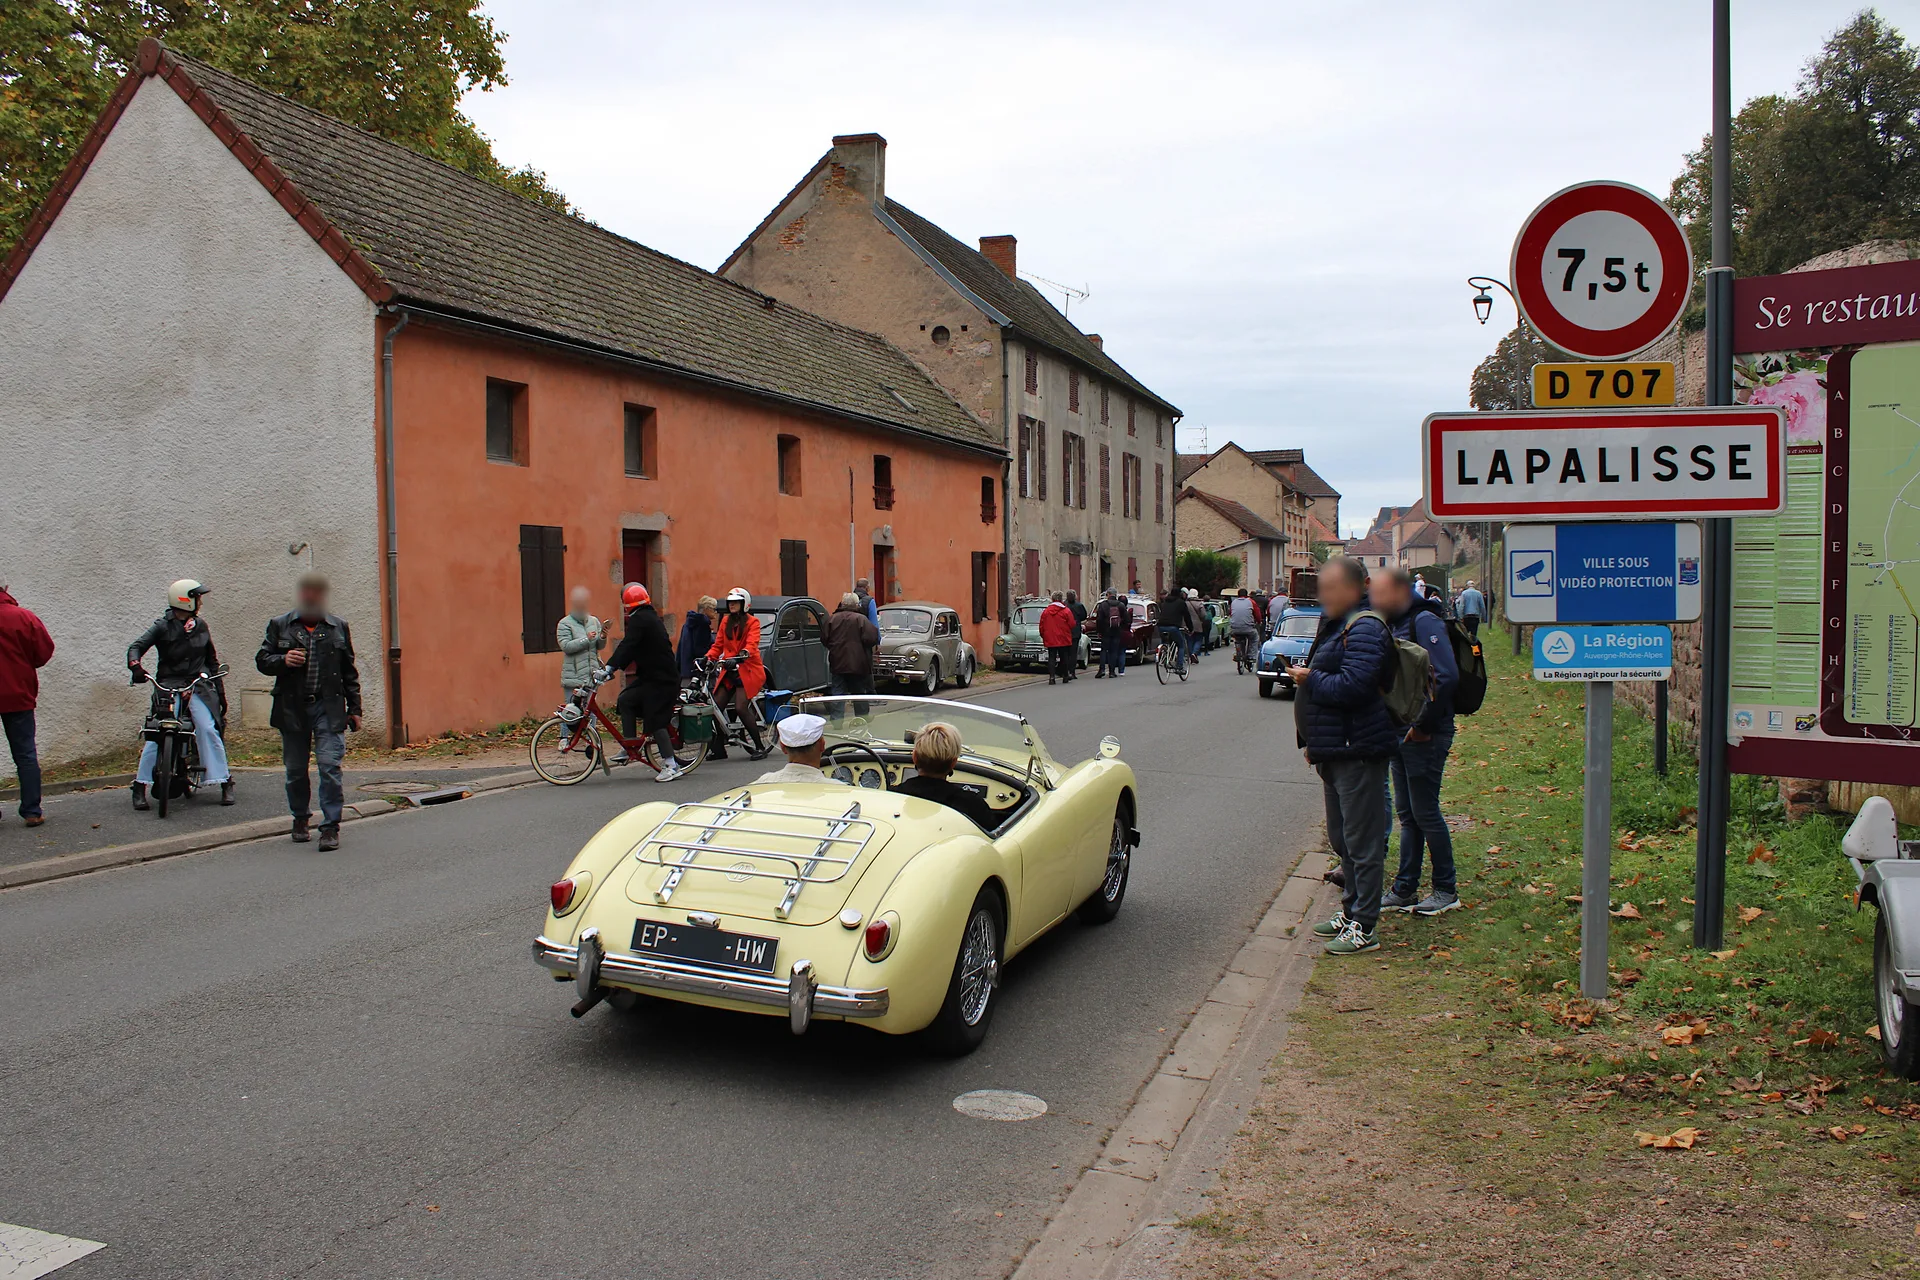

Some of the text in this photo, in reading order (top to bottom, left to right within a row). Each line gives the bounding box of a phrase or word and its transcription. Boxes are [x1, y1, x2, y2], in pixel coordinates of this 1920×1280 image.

[1755, 292, 1920, 330] Se restau
[1549, 369, 1661, 400] D 707
[1834, 390, 1844, 401] A
[1834, 428, 1843, 439] B
[1457, 444, 1752, 486] LAPALISSE
[1832, 466, 1843, 477] C
[1832, 503, 1843, 515] D
[1832, 541, 1841, 553] E
[1582, 556, 1650, 569] VILLE SOUS
[1559, 574, 1596, 589] VIDÉO
[1598, 576, 1674, 588] PROTECTION
[1832, 579, 1840, 590] F
[1829, 617, 1841, 628] G
[1583, 632, 1664, 650] La Région
[1584, 651, 1664, 661] Auvergne-Rhône-Alpes
[1829, 655, 1839, 666] H
[1543, 669, 1662, 680] La Région agit pour la sécurité
[1863, 726, 1911, 740] 1 2
